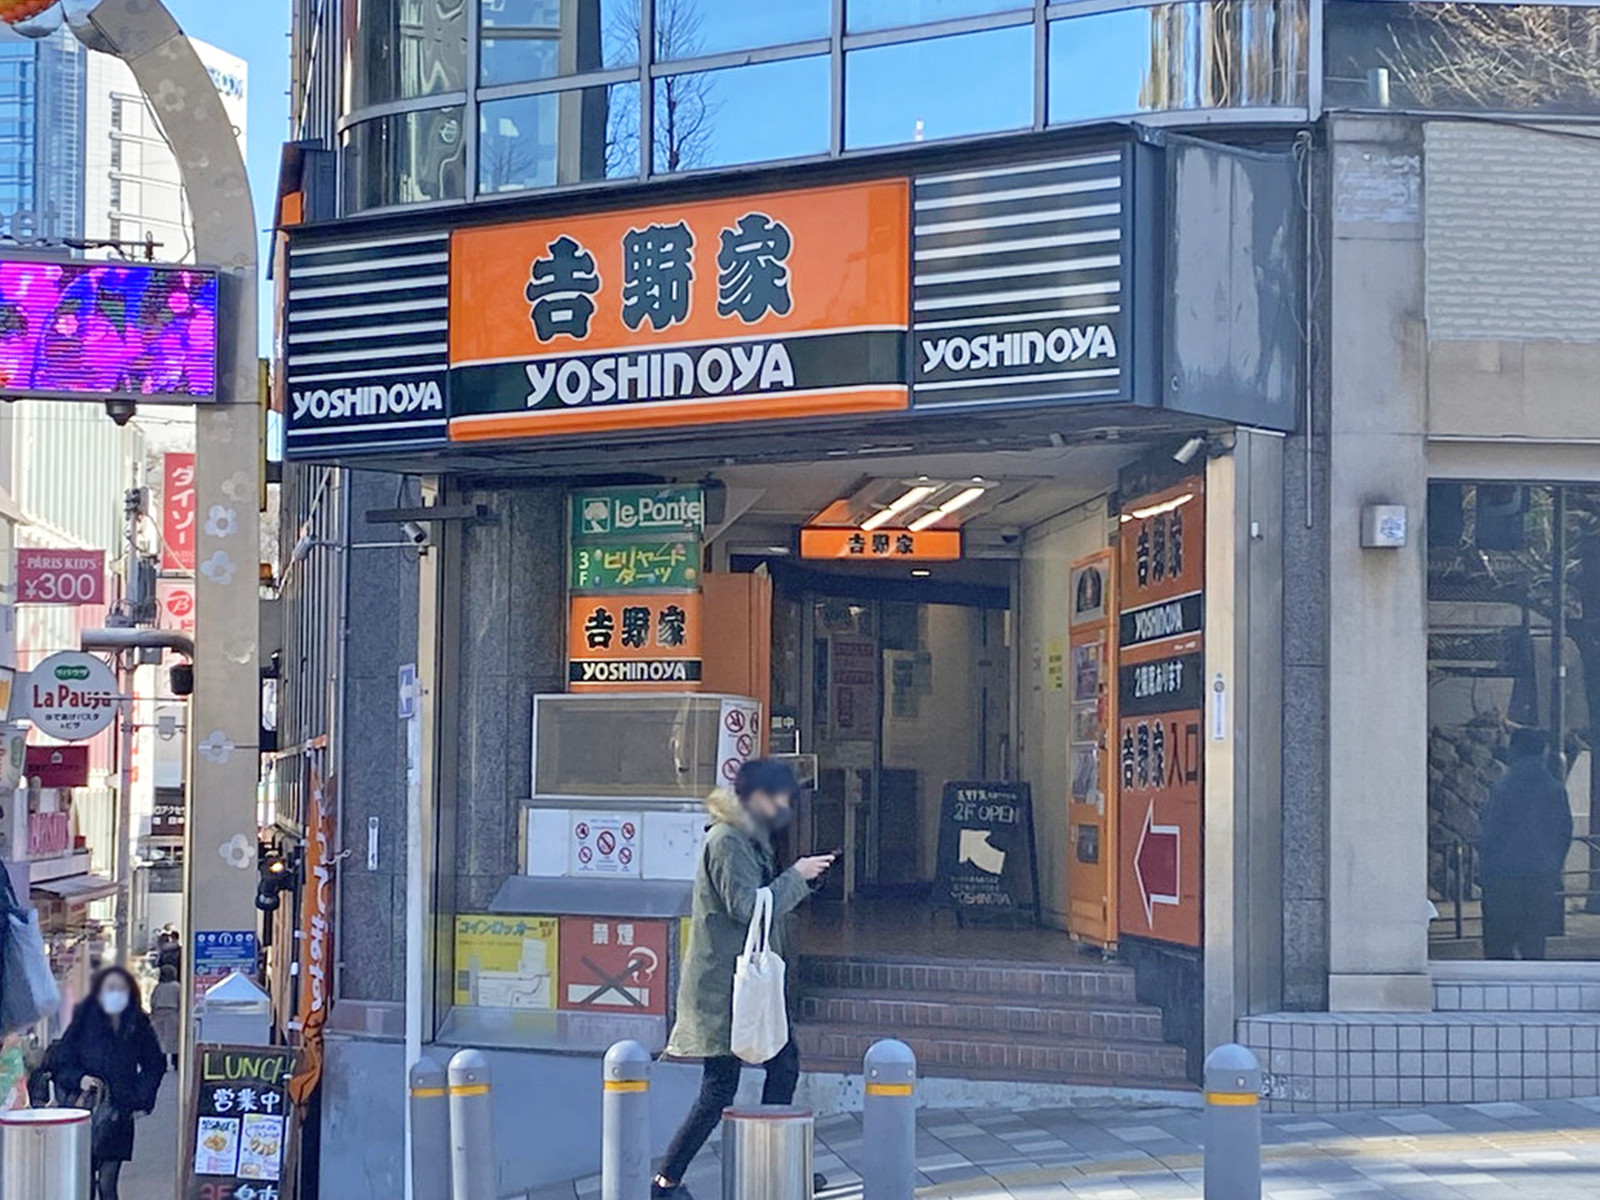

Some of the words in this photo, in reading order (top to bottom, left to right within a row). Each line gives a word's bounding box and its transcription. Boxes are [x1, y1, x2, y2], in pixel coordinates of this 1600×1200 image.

[923, 325, 1116, 373] YOSHINOYA
[525, 342, 795, 408] YOSHINOYA
[292, 380, 442, 420] YOSHINOYA
[27, 556, 62, 569] PARIS
[25, 572, 95, 600] ¥300
[582, 662, 686, 680] YOSHINOYA
[213, 1087, 281, 1113] 営業中
